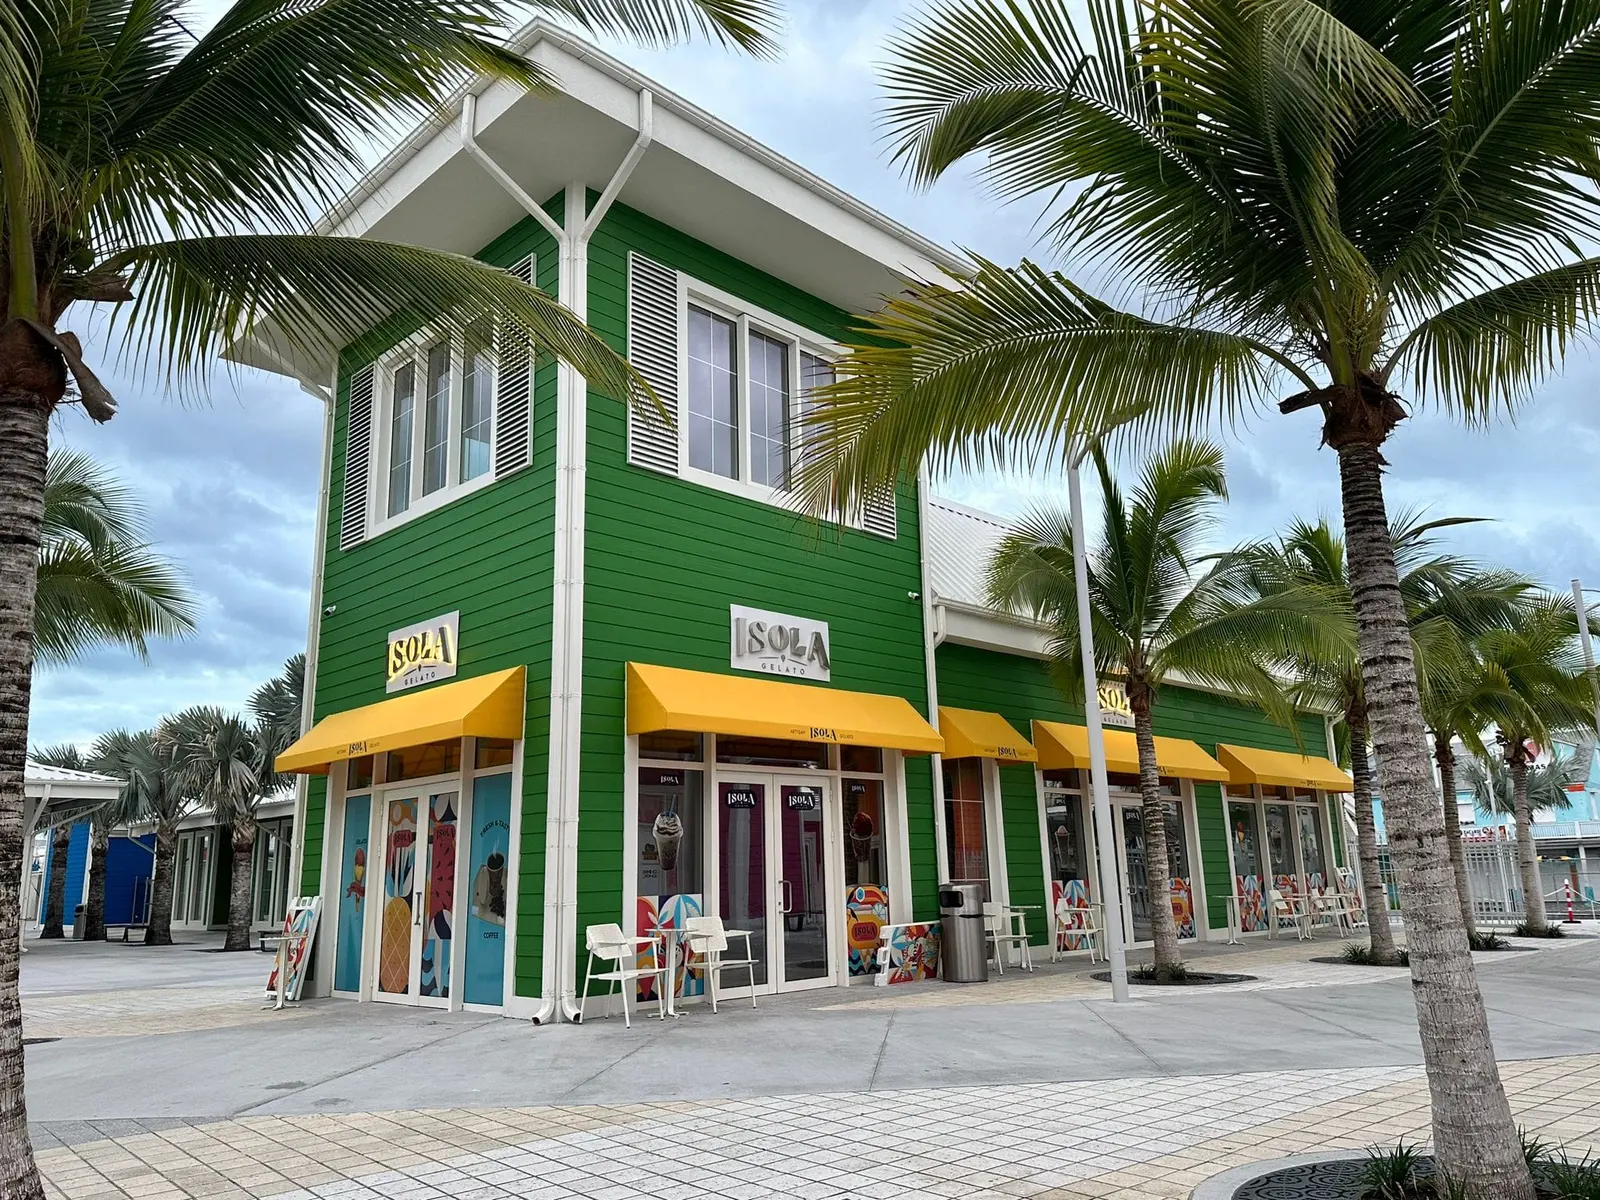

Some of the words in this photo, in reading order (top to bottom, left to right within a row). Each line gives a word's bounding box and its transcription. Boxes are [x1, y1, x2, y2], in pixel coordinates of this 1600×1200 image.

[735, 617, 830, 671] ISOLA
[387, 625, 452, 680] ISOLA
[761, 662, 805, 675] GELATO
[404, 671, 436, 686] GELATO
[1097, 686, 1128, 711] SOL
[809, 727, 837, 741] ISOLA
[997, 746, 1018, 758] ISOLA
[660, 775, 679, 784] ISOLA
[727, 793, 755, 805] ISOLA
[788, 795, 814, 807] ISOLA
[480, 819, 495, 837] FRESH
[854, 926, 877, 937] ISOLA
